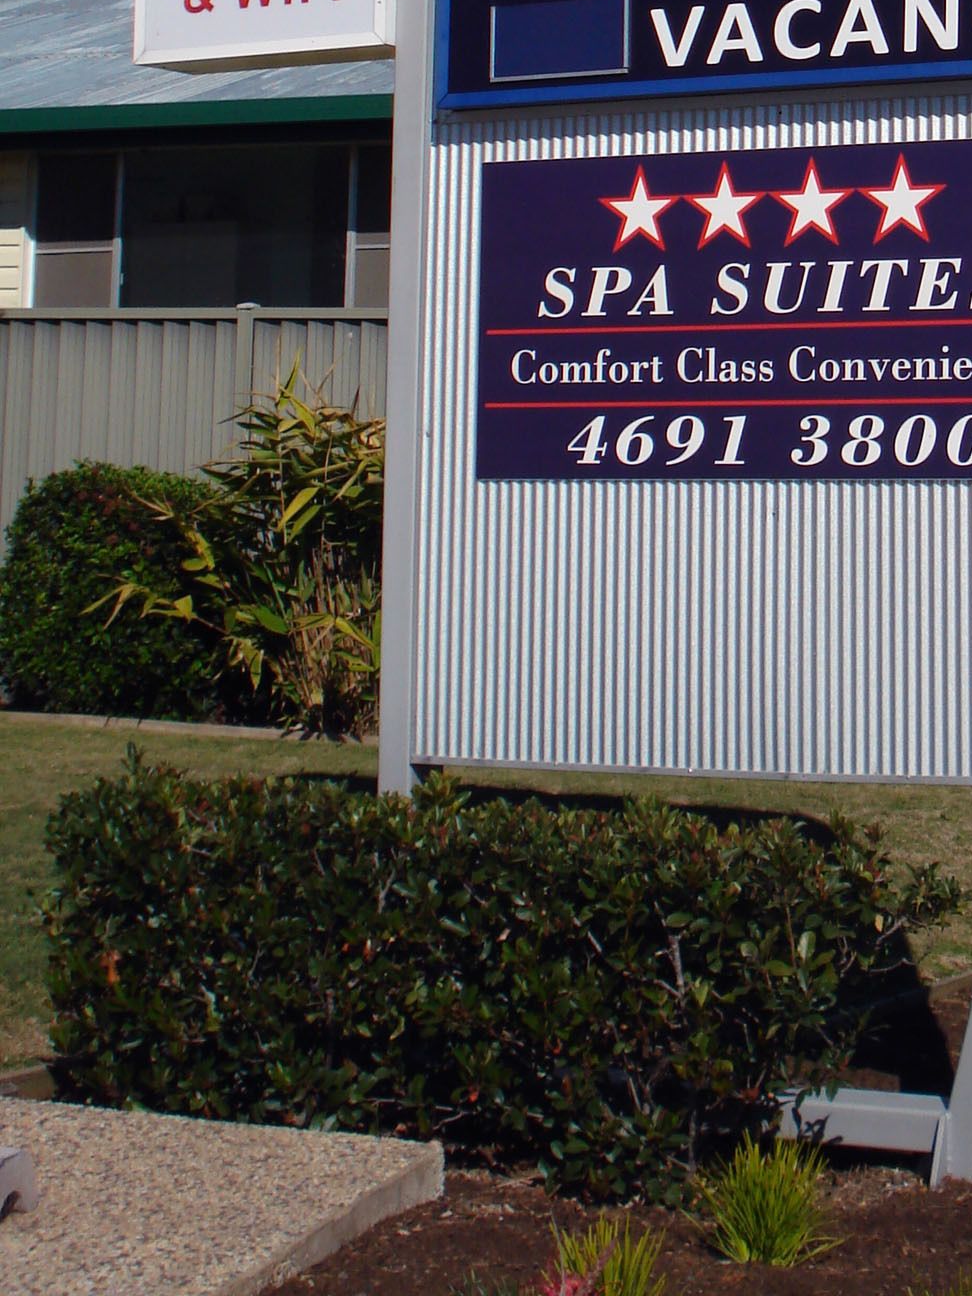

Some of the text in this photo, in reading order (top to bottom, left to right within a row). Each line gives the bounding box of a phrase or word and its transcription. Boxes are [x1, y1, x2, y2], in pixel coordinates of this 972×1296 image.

[538, 264, 674, 318] SPA
[511, 348, 664, 385] Comfort
[677, 347, 774, 384] Class
[566, 415, 747, 467] 4691
